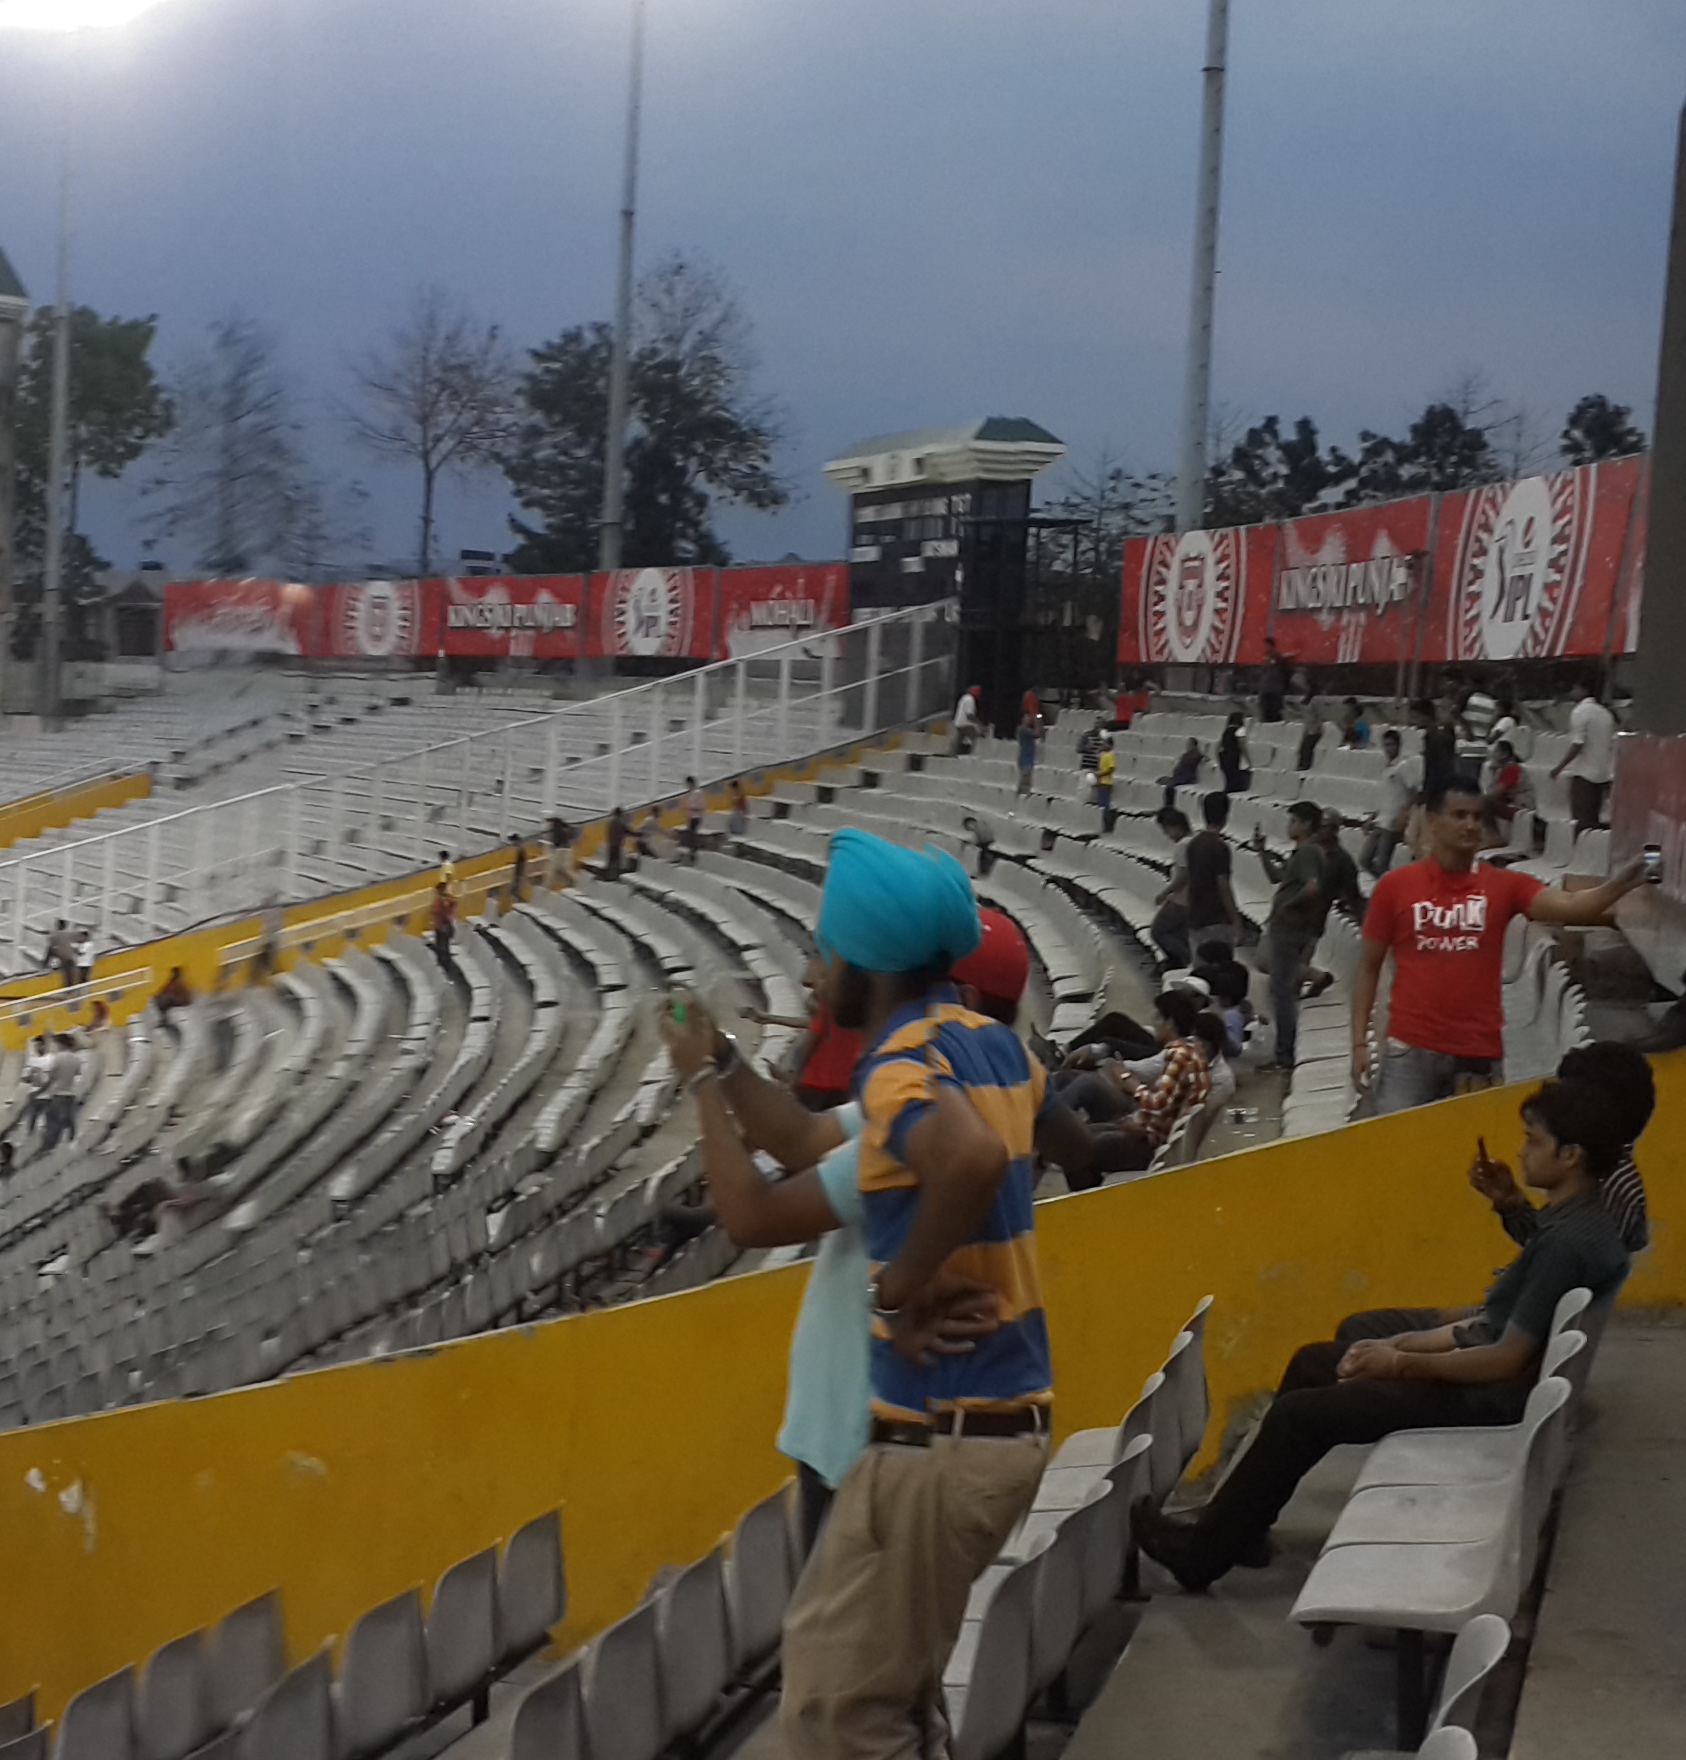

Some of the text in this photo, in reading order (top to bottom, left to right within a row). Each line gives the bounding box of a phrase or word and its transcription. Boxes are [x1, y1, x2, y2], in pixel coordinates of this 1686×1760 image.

[446, 603, 494, 629] KINGS
[513, 602, 578, 633] PUNJAB
[750, 599, 815, 627] MOHALI
